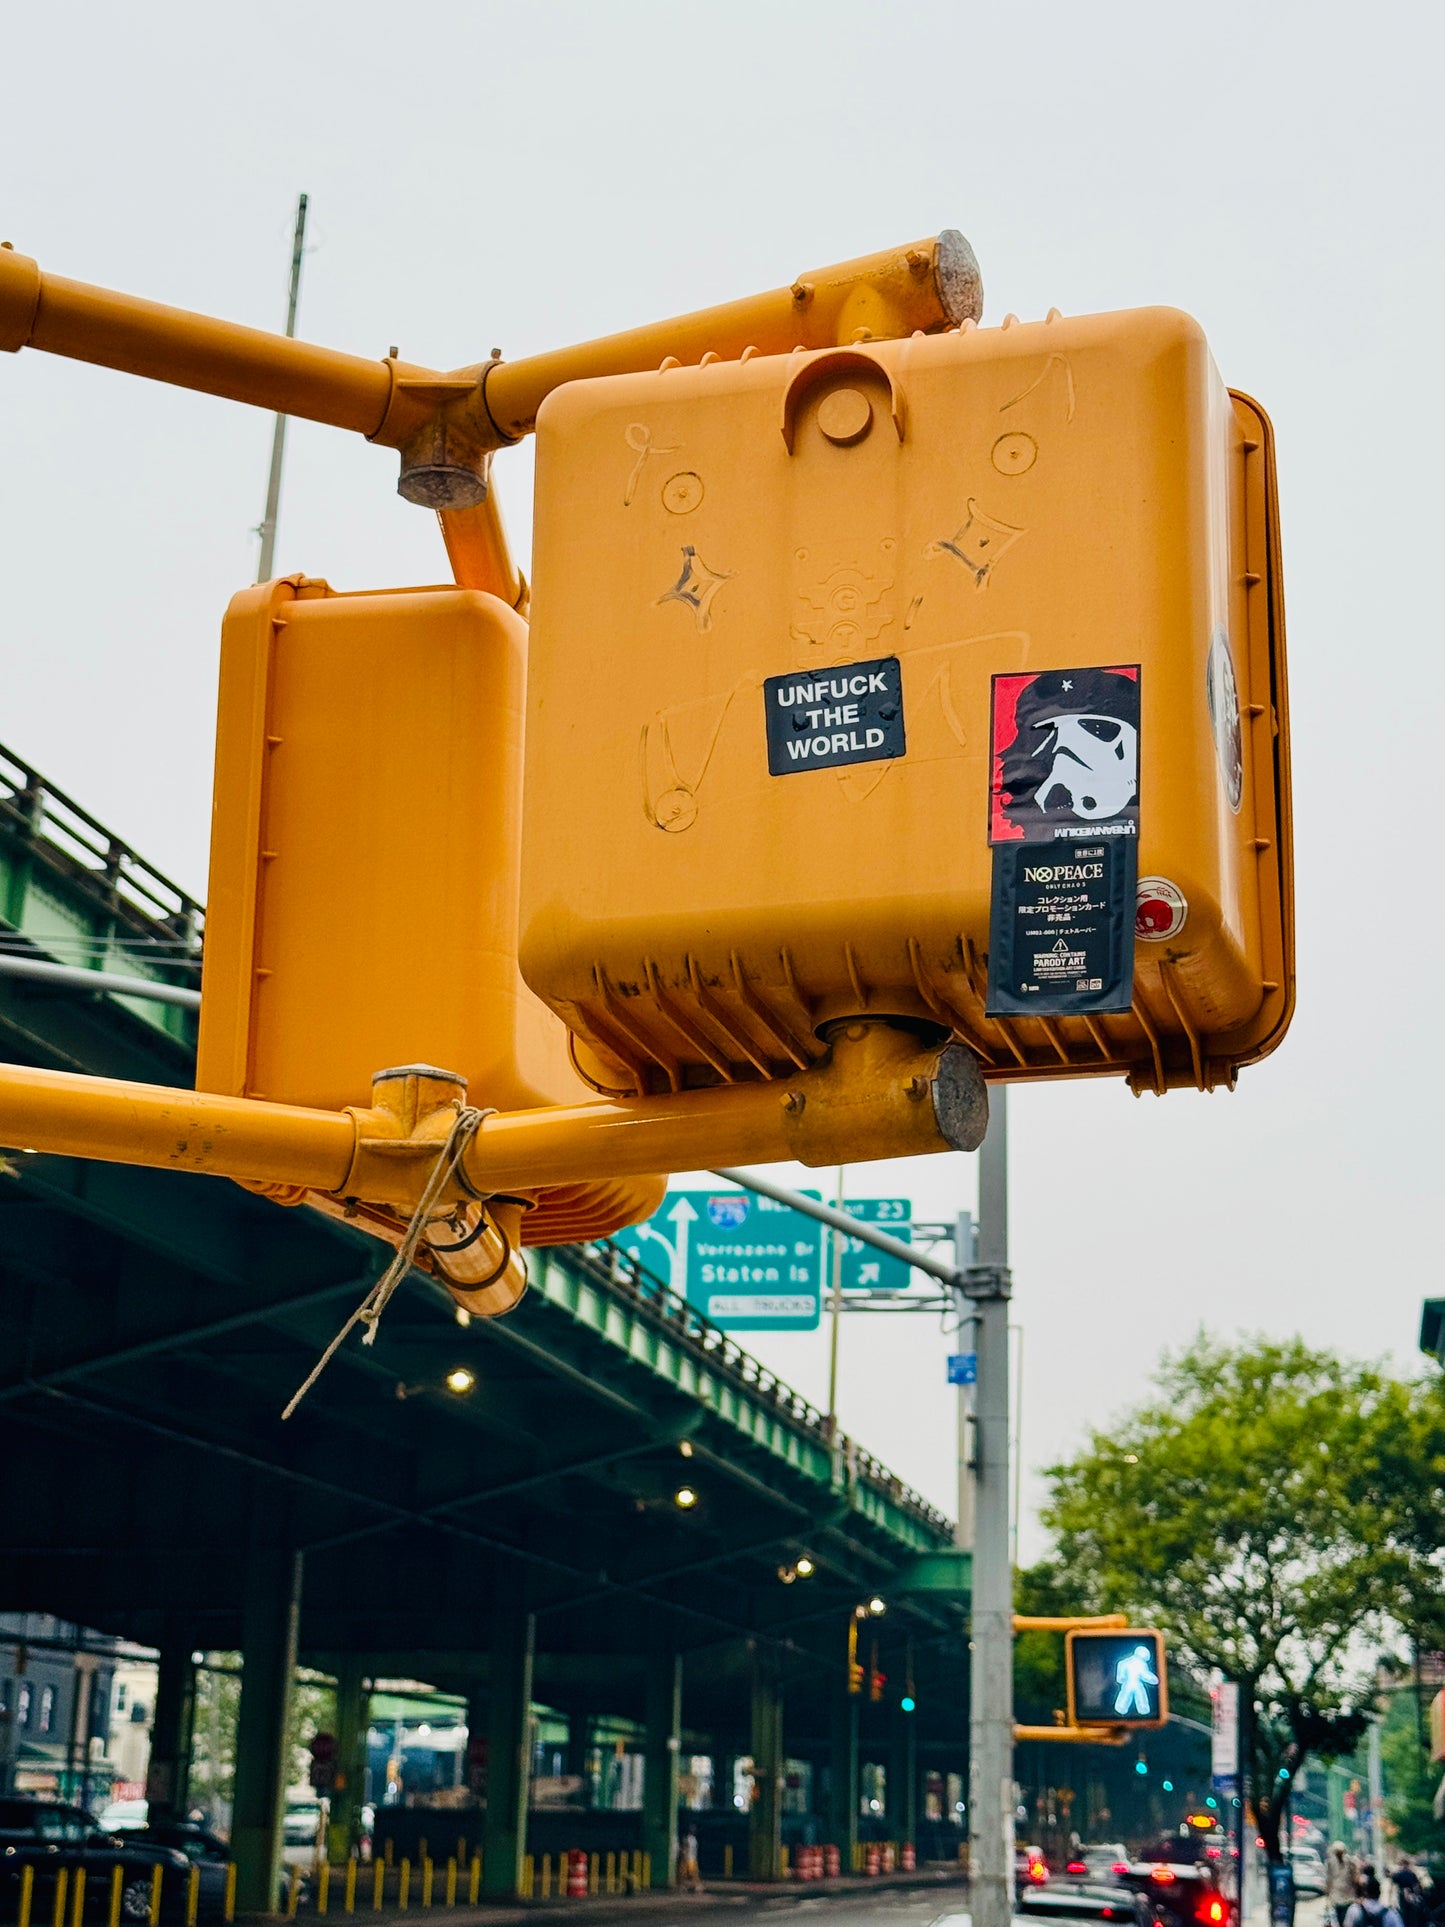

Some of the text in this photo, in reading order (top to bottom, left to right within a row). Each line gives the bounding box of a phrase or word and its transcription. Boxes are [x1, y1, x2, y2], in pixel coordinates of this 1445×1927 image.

[778, 672, 888, 707] UNFUCK
[806, 704, 859, 729] THE
[787, 728, 885, 760] WORLD
[1054, 825, 1136, 838] URBANMEDIUM
[1033, 957, 1085, 967] PARODY ART
[877, 1201, 904, 1219] 23
[701, 1263, 809, 1283] Staten Is
